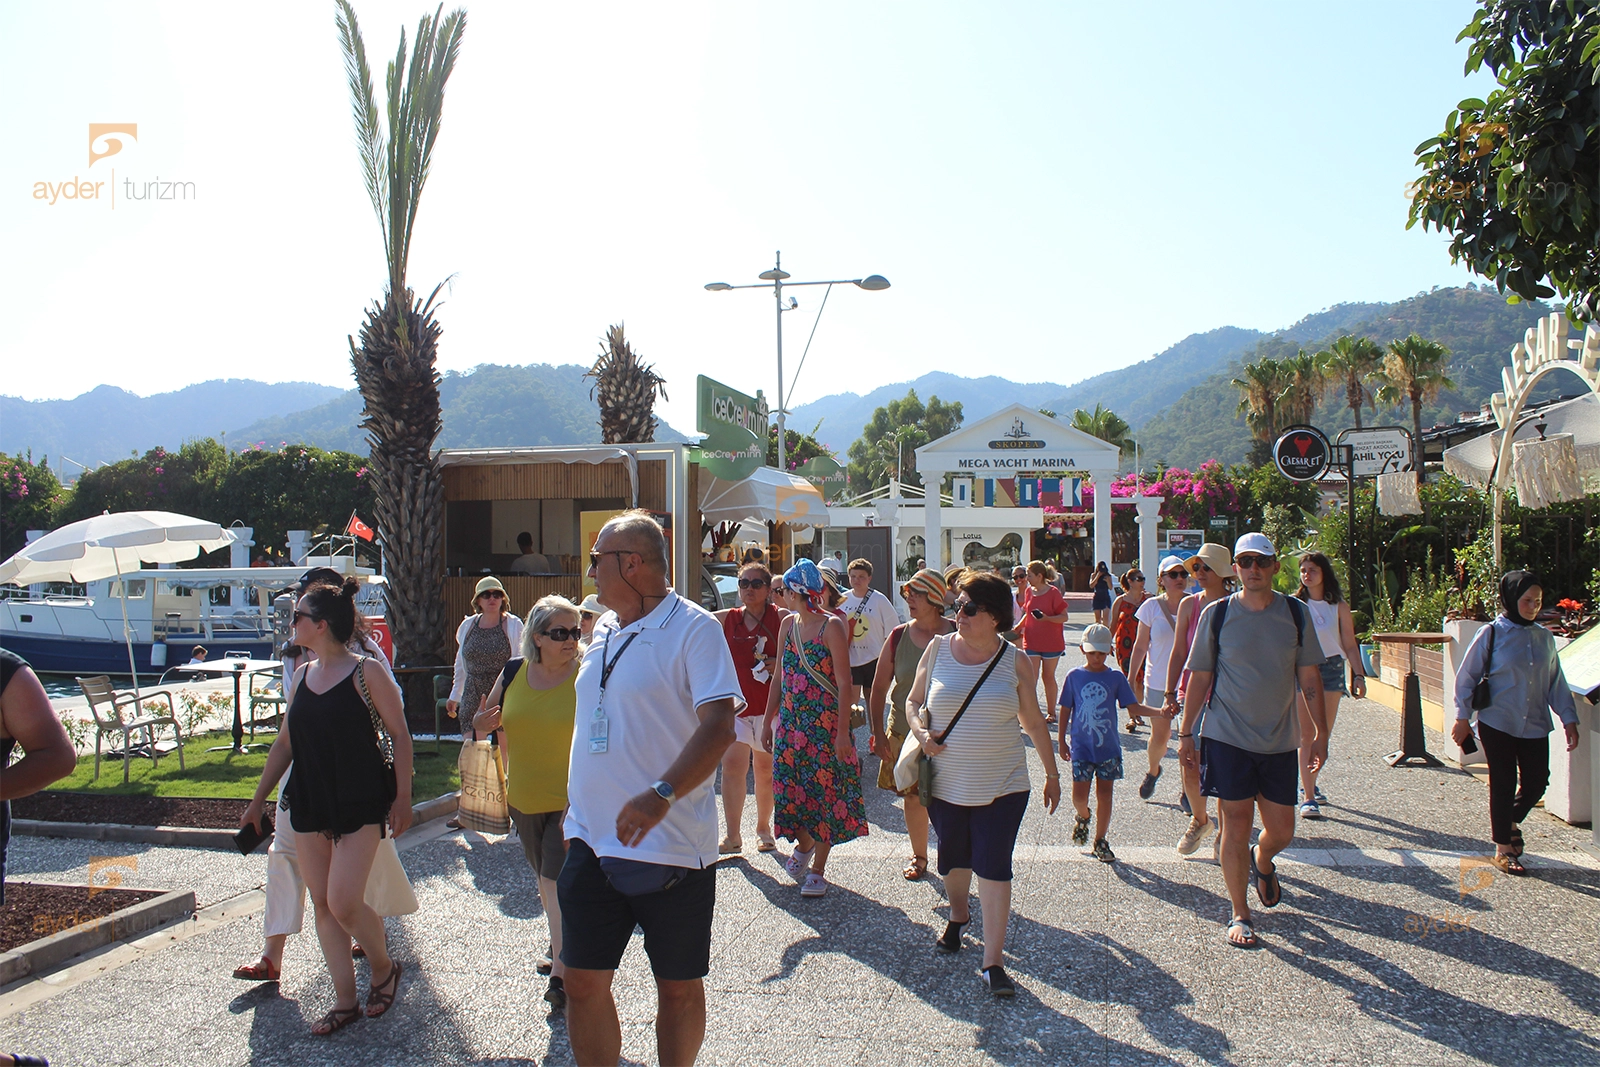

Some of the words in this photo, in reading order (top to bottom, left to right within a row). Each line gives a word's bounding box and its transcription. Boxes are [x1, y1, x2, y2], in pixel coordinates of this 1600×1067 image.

[1353, 450, 1376, 462] AHİL
[958, 459, 990, 468] MEGA
[993, 458, 1029, 468] YACHT
[1032, 458, 1076, 467] MARINA
[462, 785, 504, 803] czane
